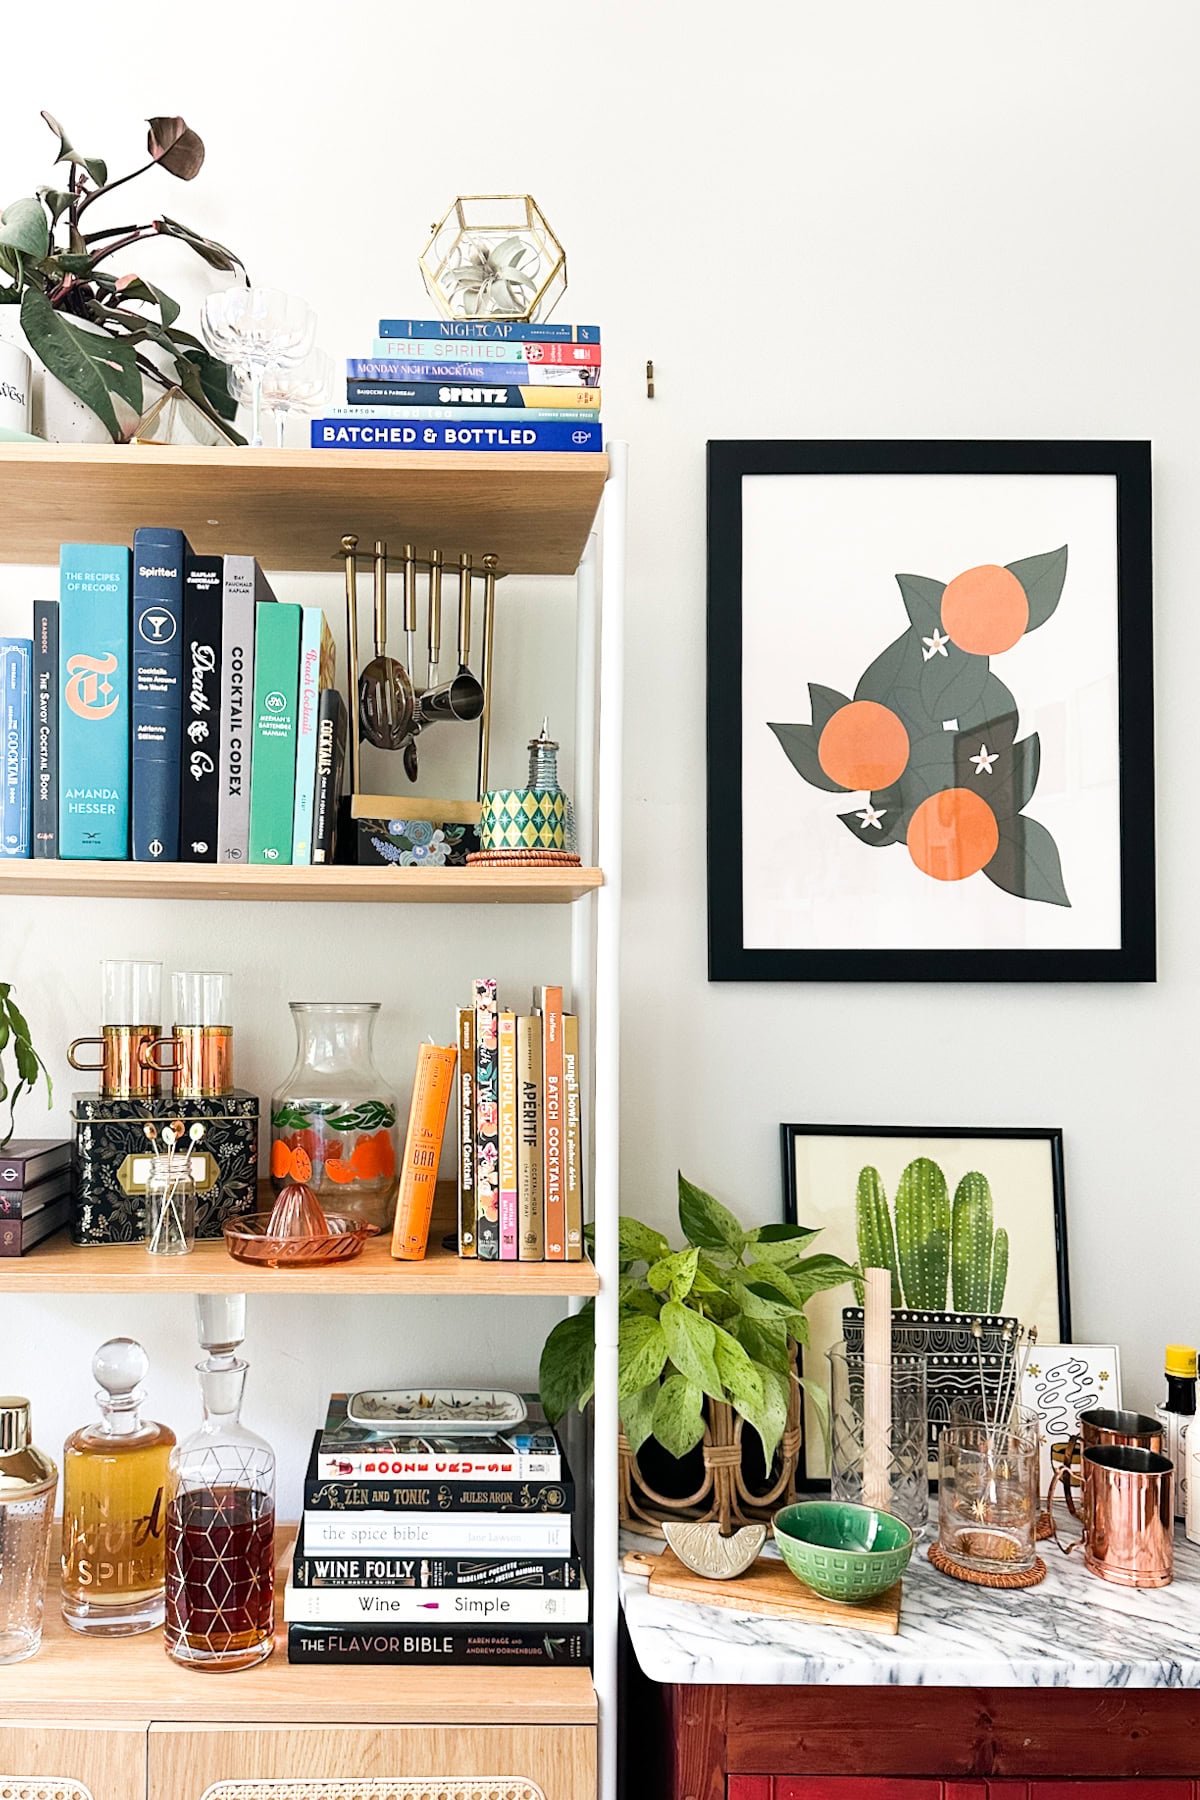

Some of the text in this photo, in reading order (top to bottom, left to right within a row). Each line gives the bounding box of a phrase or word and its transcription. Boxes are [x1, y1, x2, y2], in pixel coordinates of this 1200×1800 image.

[440, 323, 513, 337] NIGHTCAP
[387, 342, 506, 358] FREE SPIRITED
[357, 363, 484, 377] MONDAY NIGHT MOCKTAILS
[438, 386, 508, 404] SPRITZ
[323, 426, 537, 444] BATCHED & BOTTLED
[65, 572, 120, 582] THE RECIPES
[139, 566, 177, 578] Spirited
[67, 583, 118, 592] OF RECORD
[190, 641, 216, 715] Death
[302, 648, 318, 736] Beach Cocktails
[228, 646, 244, 796] COCKTAIL CODEX
[318, 720, 333, 775] COCKTAILS
[8, 731, 19, 786] COCKTAIL
[190, 750, 214, 782] Co
[65, 788, 119, 800] AMANDA
[69, 802, 116, 814] HESSER
[565, 1054, 578, 1090] punch
[502, 1046, 514, 1182] MINDFUL MOCKTAIL
[523, 1081, 540, 1148] APÉRITIF
[567, 1094, 579, 1128] bowls
[548, 1076, 560, 1203] BATCH COCKTAILS
[414, 1150, 435, 1167] BAR
[365, 1462, 428, 1474] BOOZE
[436, 1462, 512, 1473] CRUISE
[344, 1488, 430, 1506] ZEN AND TONIC
[460, 1492, 513, 1504] JULES ARON
[323, 1526, 428, 1544] the spice bible
[314, 1560, 360, 1578] WINE
[366, 1560, 414, 1578] FOLLY
[358, 1596, 510, 1616] Wine Simple
[301, 1636, 454, 1653] THE FLAVOR BIBLE
